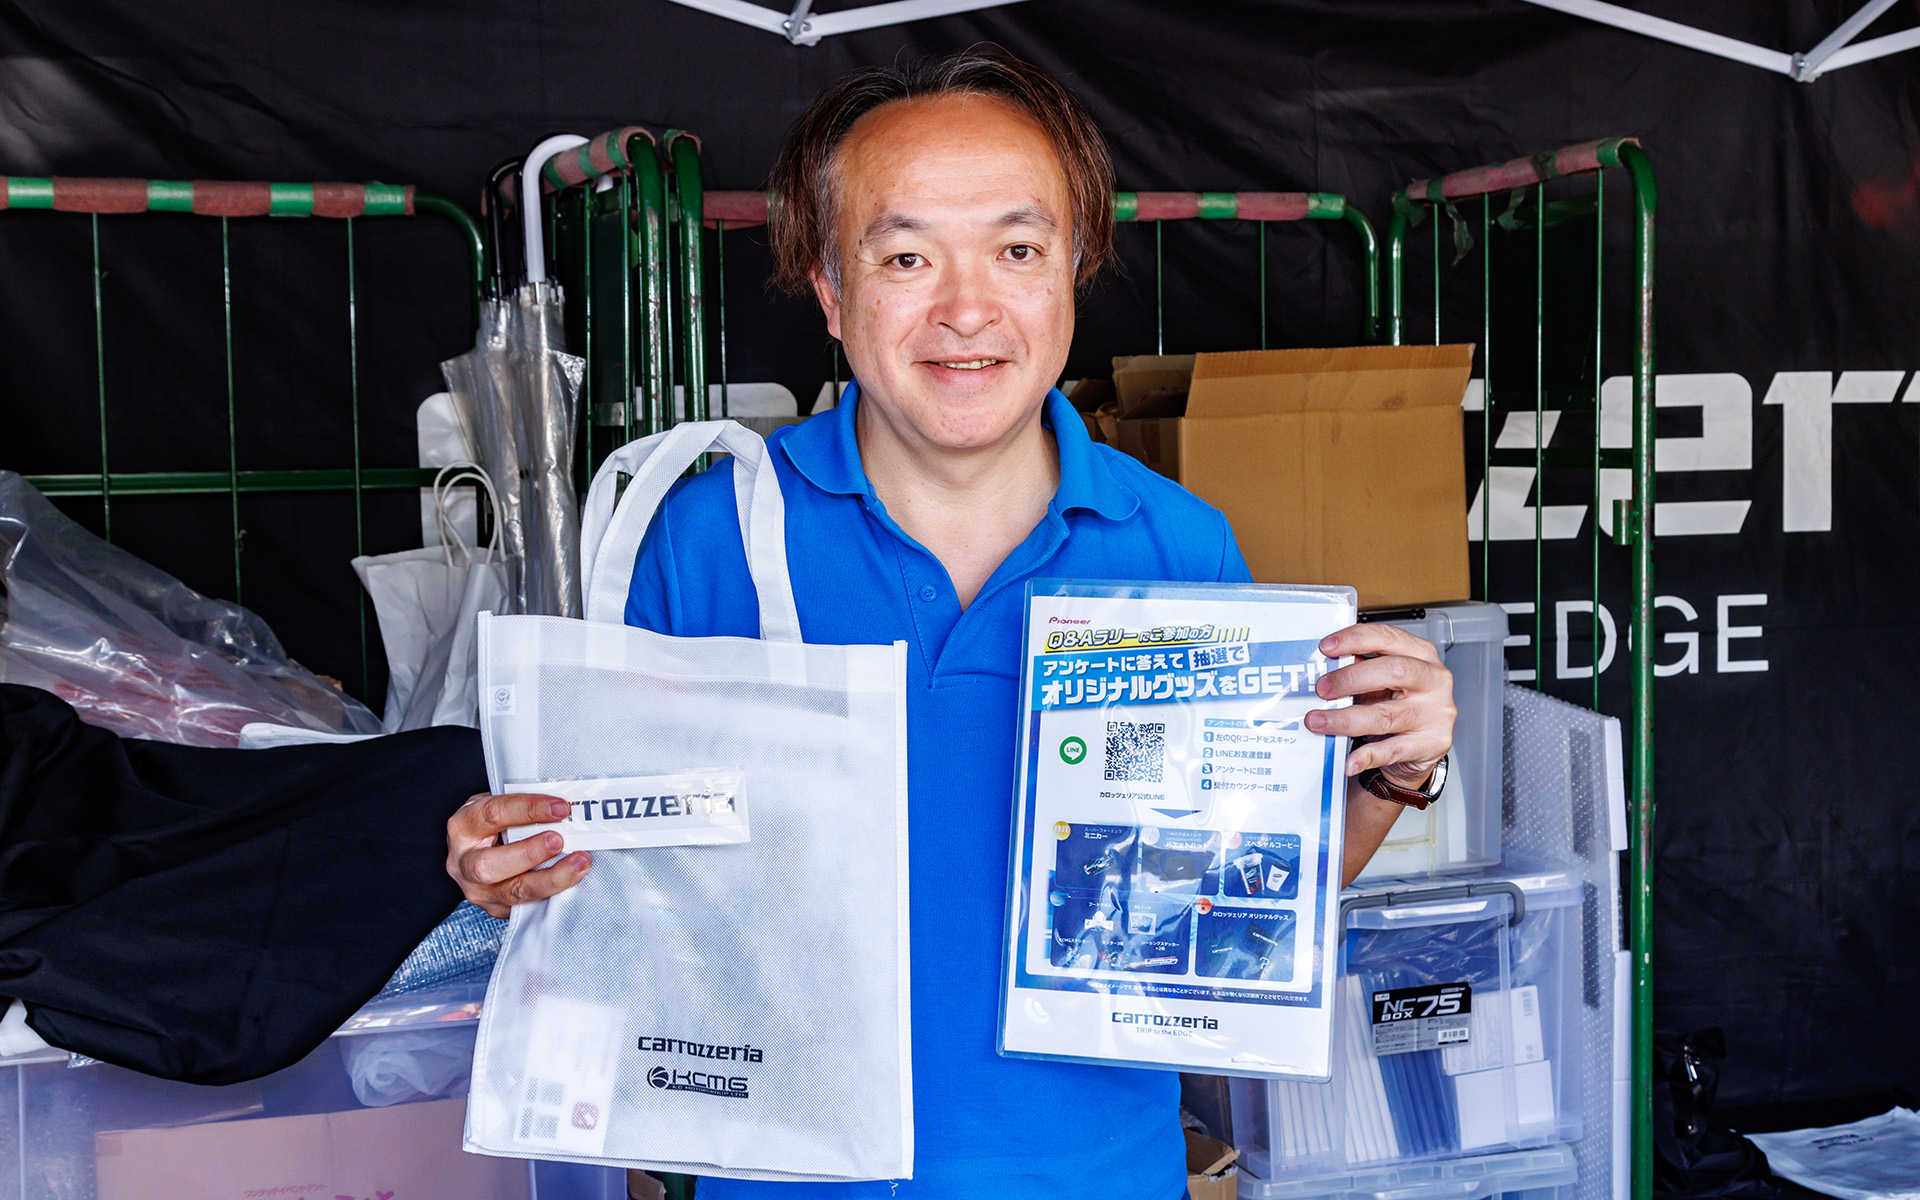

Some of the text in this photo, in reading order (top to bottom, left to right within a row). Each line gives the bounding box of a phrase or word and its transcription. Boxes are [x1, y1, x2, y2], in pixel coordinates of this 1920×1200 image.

[1048, 624, 1213, 649] Q&Aラリーにご参加の方
[1043, 645, 1245, 676] アンケートに答えて 抽選で
[1216, 733, 1297, 744] 左のQRコードをスキャン
[1215, 750, 1272, 759] LINEお友達登録
[1214, 766, 1272, 776] アンケートに回答
[1214, 781, 1288, 792] 受付カウンターに提示
[1099, 791, 1165, 800] カロッツェリア公式LINE
[1244, 840, 1299, 849] スペシャルコーヒー
[1249, 913, 1289, 921] オリジナルグッズ
[1383, 993, 1462, 1016] NC 75
[1112, 1011, 1218, 1030] carrozzeria
[1381, 1011, 1413, 1021] BOX
[638, 1036, 763, 1063] carrozzeria
[672, 1069, 748, 1091] KCMG
